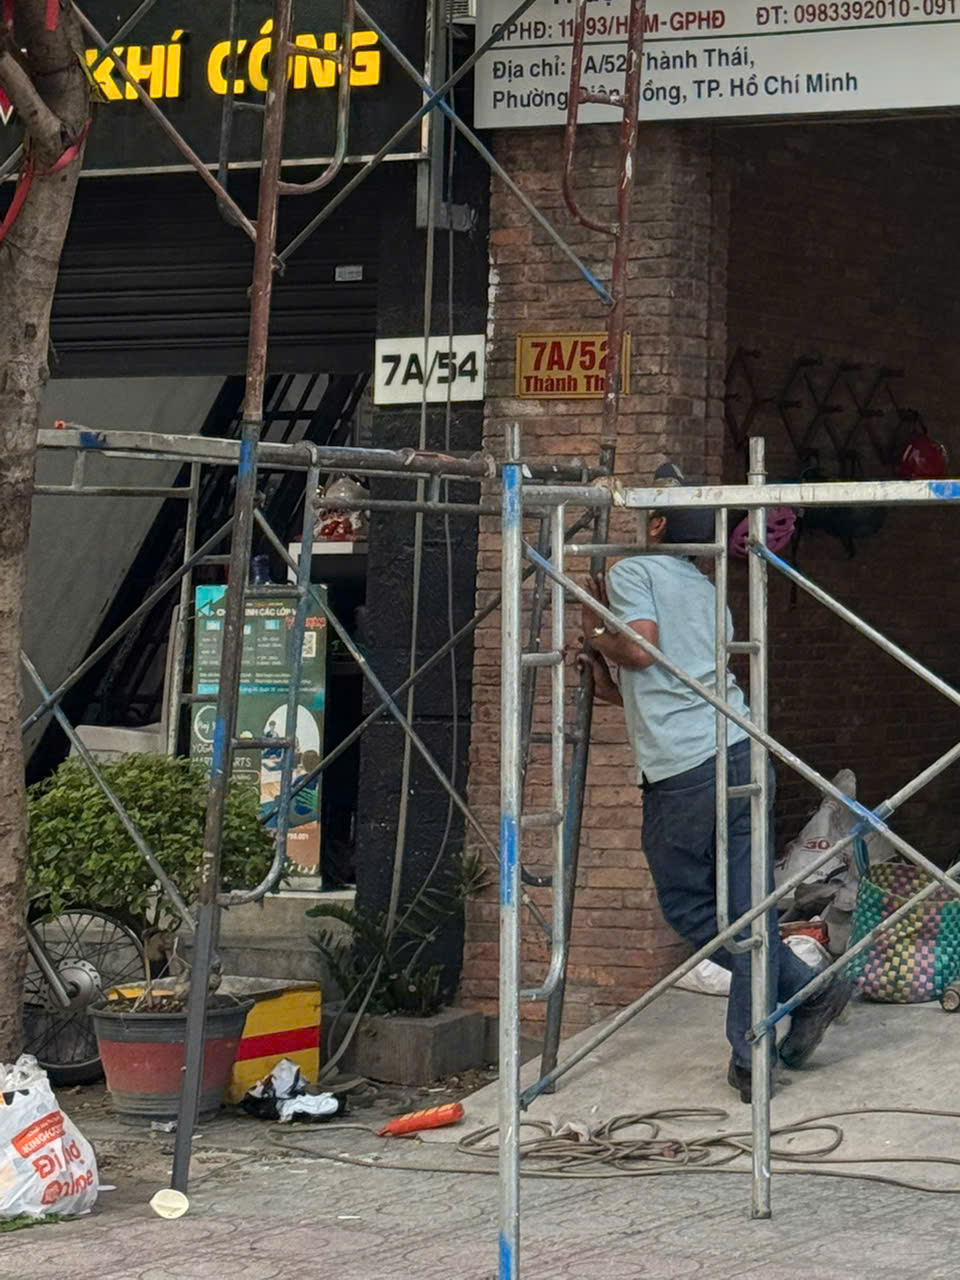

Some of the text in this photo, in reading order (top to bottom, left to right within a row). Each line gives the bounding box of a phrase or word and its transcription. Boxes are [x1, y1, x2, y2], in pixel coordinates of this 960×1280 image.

[756, 6, 789, 27] ĐT:
[85, 29, 184, 102] KHÍ
[492, 46, 755, 83] Địa chỉ: A/52 hành Thái,
[492, 86, 569, 111] Phường
[642, 79, 688, 105] ồng,
[693, 79, 724, 99] TP.
[730, 73, 759, 97] Hồ
[764, 74, 800, 95] Chí
[806, 72, 858, 93] Minh
[380, 350, 479, 387] 7A/54
